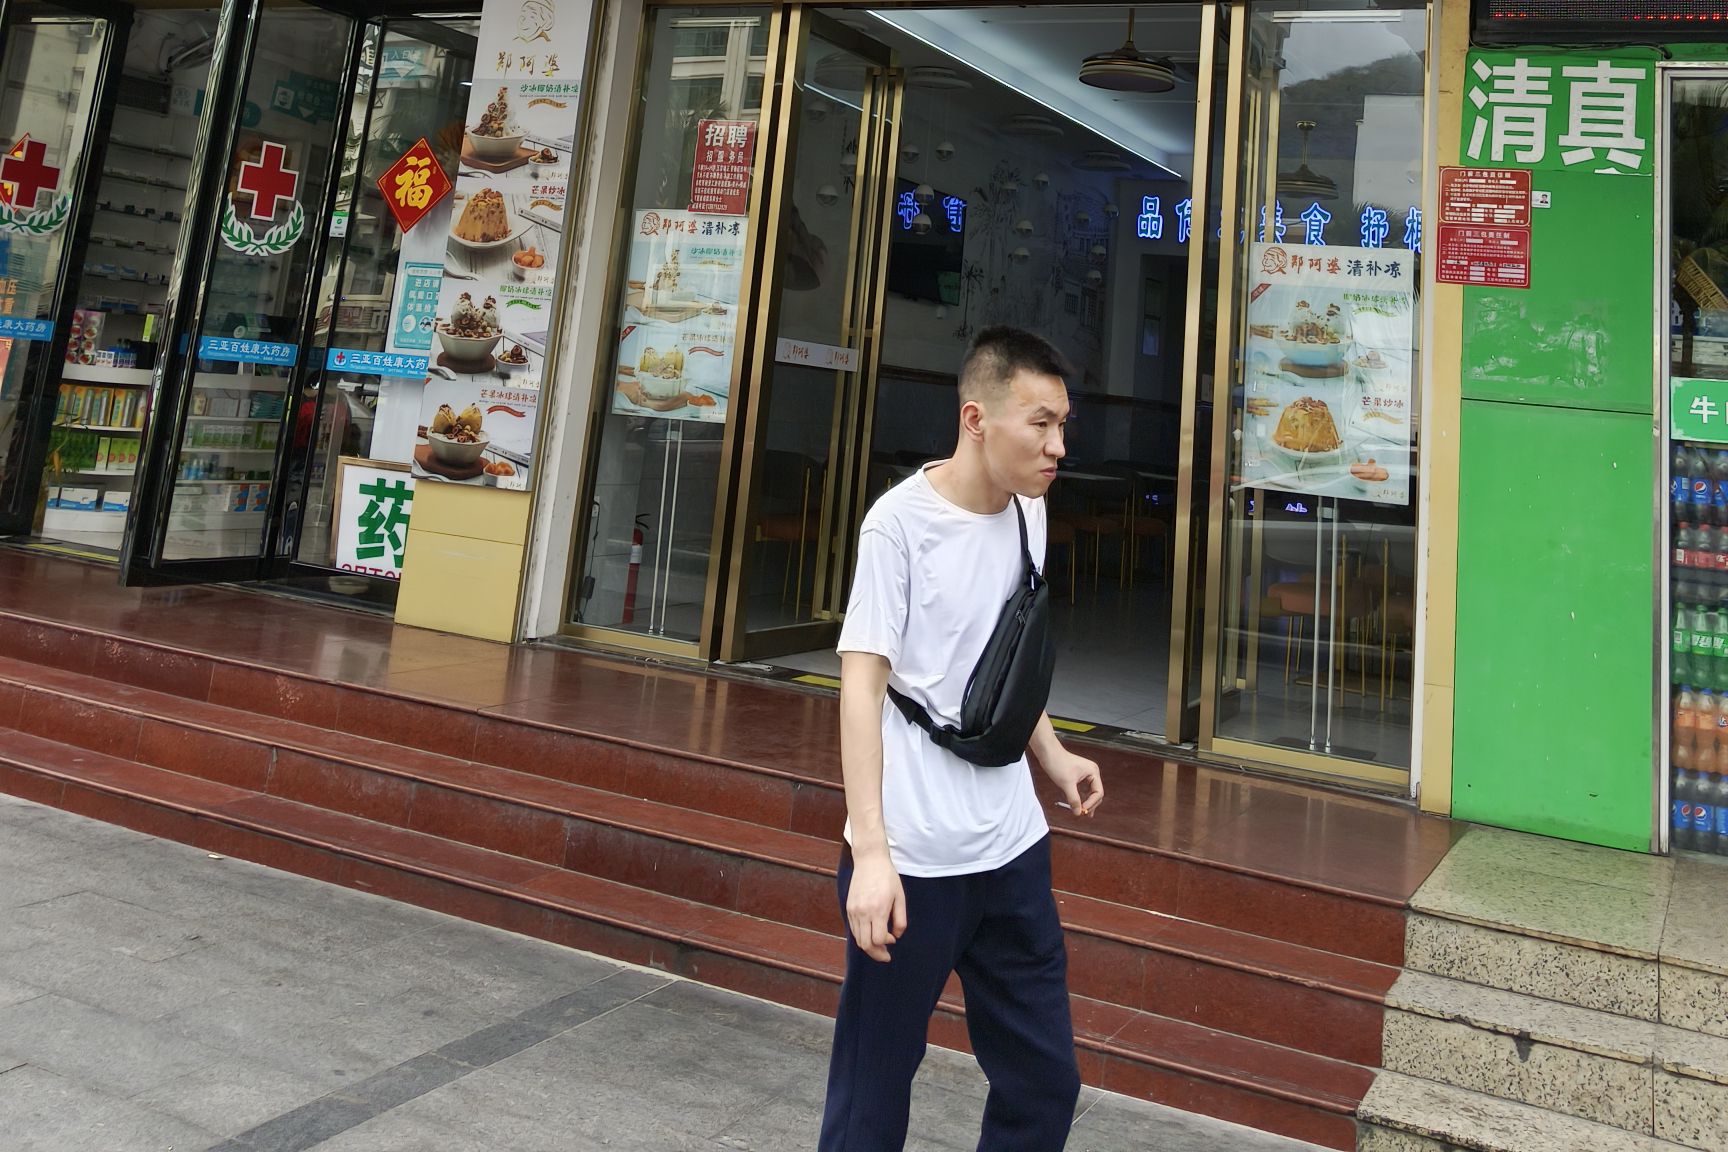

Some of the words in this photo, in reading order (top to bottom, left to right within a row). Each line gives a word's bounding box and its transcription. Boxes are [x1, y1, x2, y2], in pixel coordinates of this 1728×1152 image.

[1466, 57, 1648, 170] 清真
[705, 124, 748, 148] 招聘
[395, 156, 434, 210] 福
[702, 221, 741, 236] 清补凉
[1291, 254, 1341, 275] 郑阿婆
[1346, 259, 1402, 278] 清补凉
[350, 353, 428, 370] 三亚百姓康大药
[356, 477, 414, 569] 药
